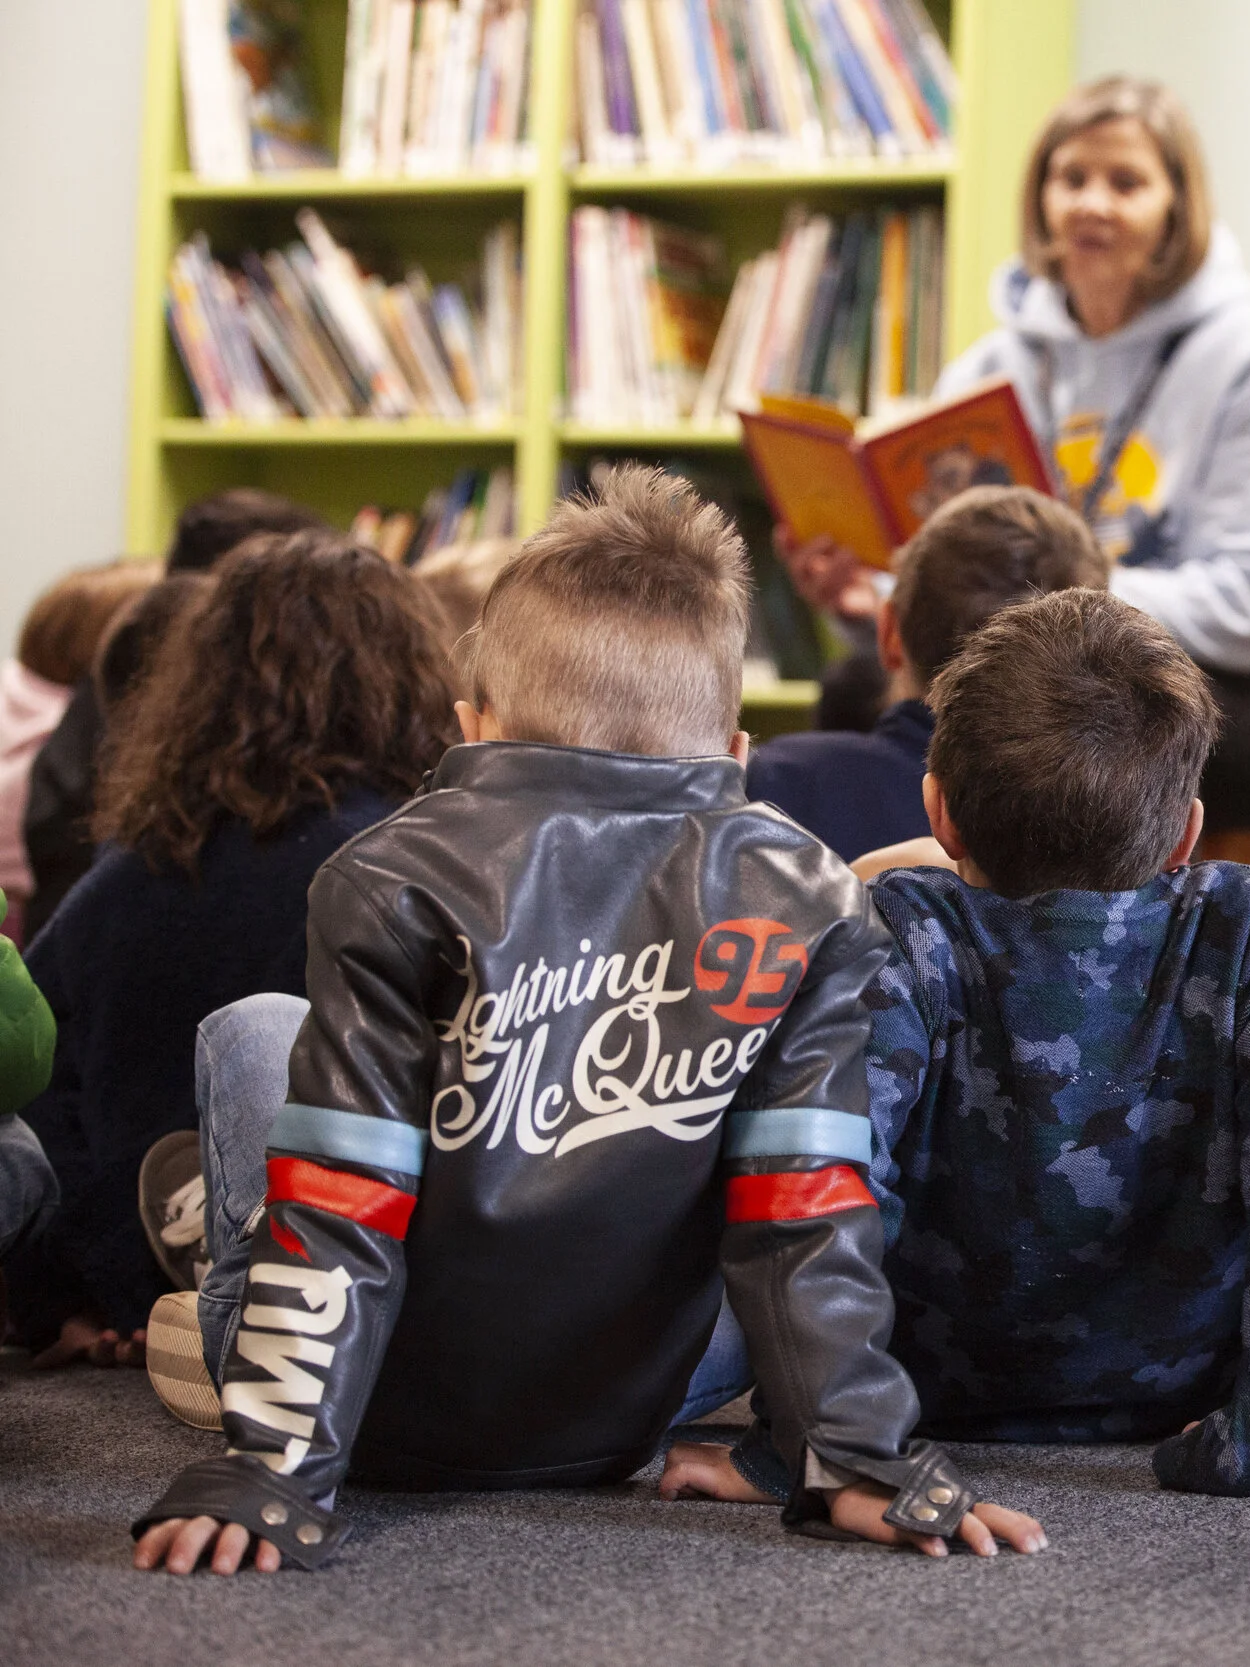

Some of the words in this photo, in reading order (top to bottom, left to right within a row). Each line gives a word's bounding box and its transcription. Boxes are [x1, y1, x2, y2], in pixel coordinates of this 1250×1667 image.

[433, 934, 691, 1083] Lghtning
[699, 929, 806, 1009] 95
[430, 1001, 781, 1158] McQuee
